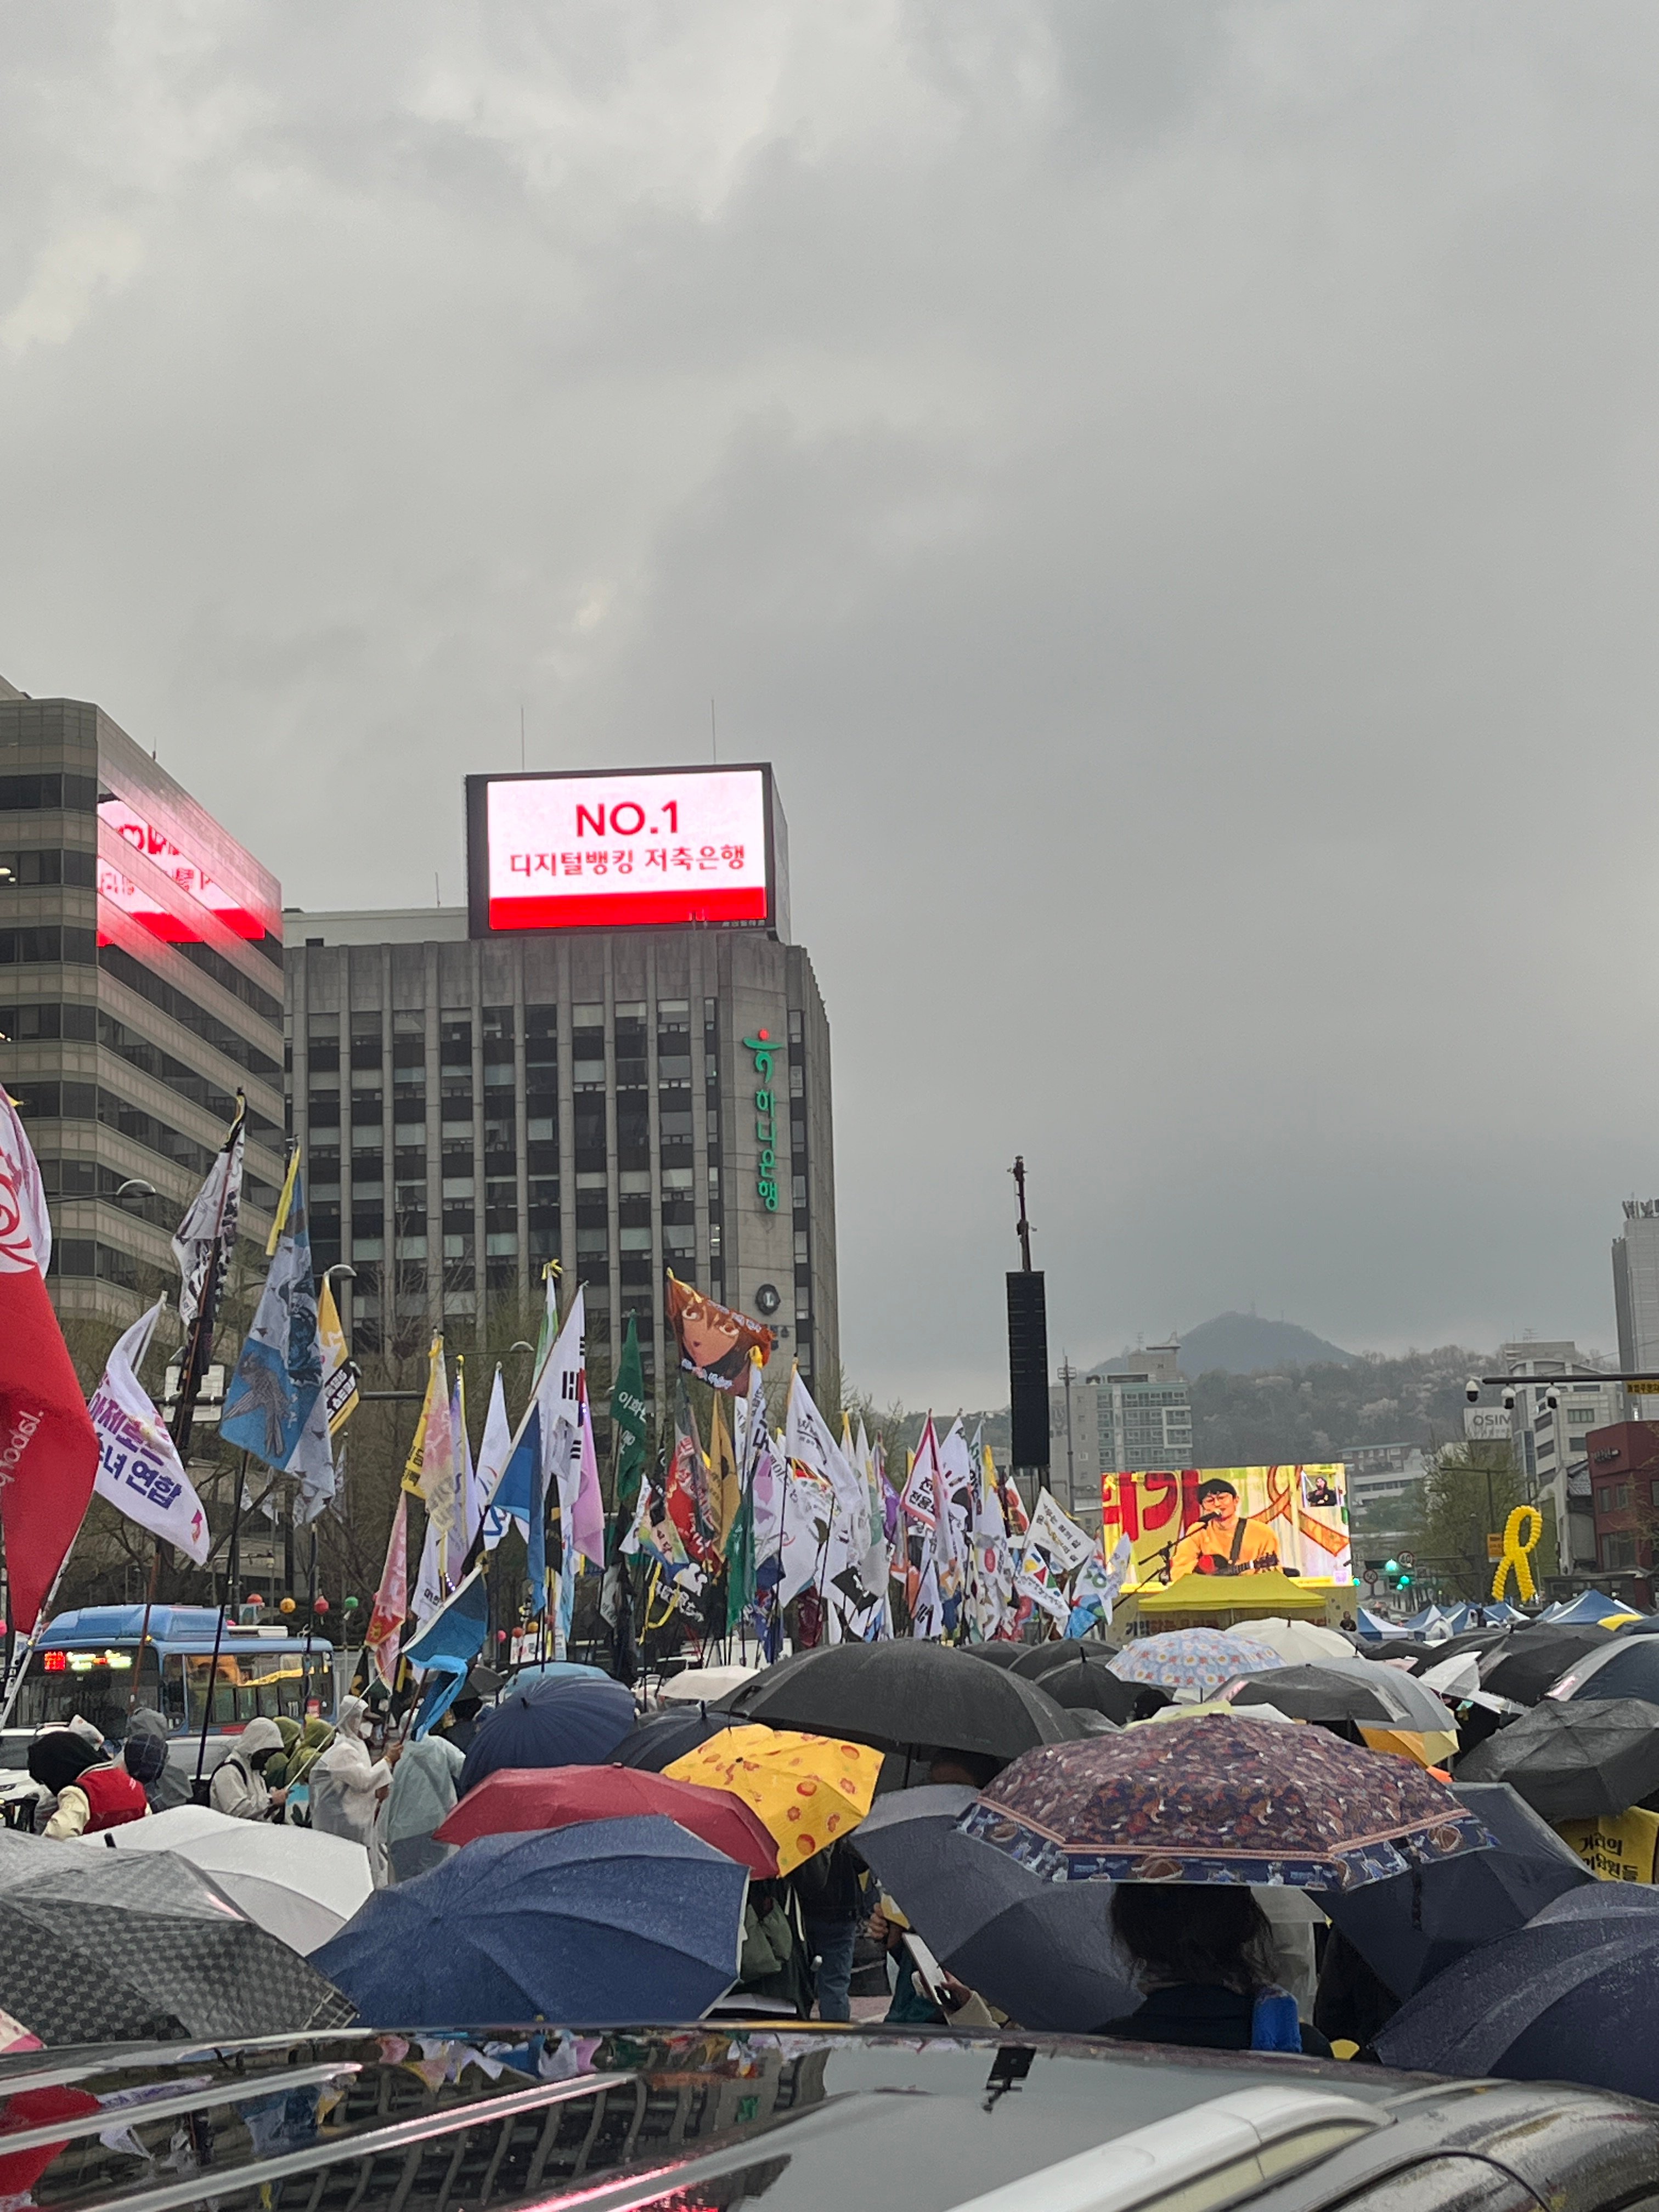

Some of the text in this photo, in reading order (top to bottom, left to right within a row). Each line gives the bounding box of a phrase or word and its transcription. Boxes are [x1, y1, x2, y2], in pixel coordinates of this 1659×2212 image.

[576, 800, 678, 837] NO.1
[510, 844, 745, 877] 디지털뱅킹 저축은행
[755, 1088, 778, 1211] 하나은행
[126, 1460, 182, 1510] 연합
